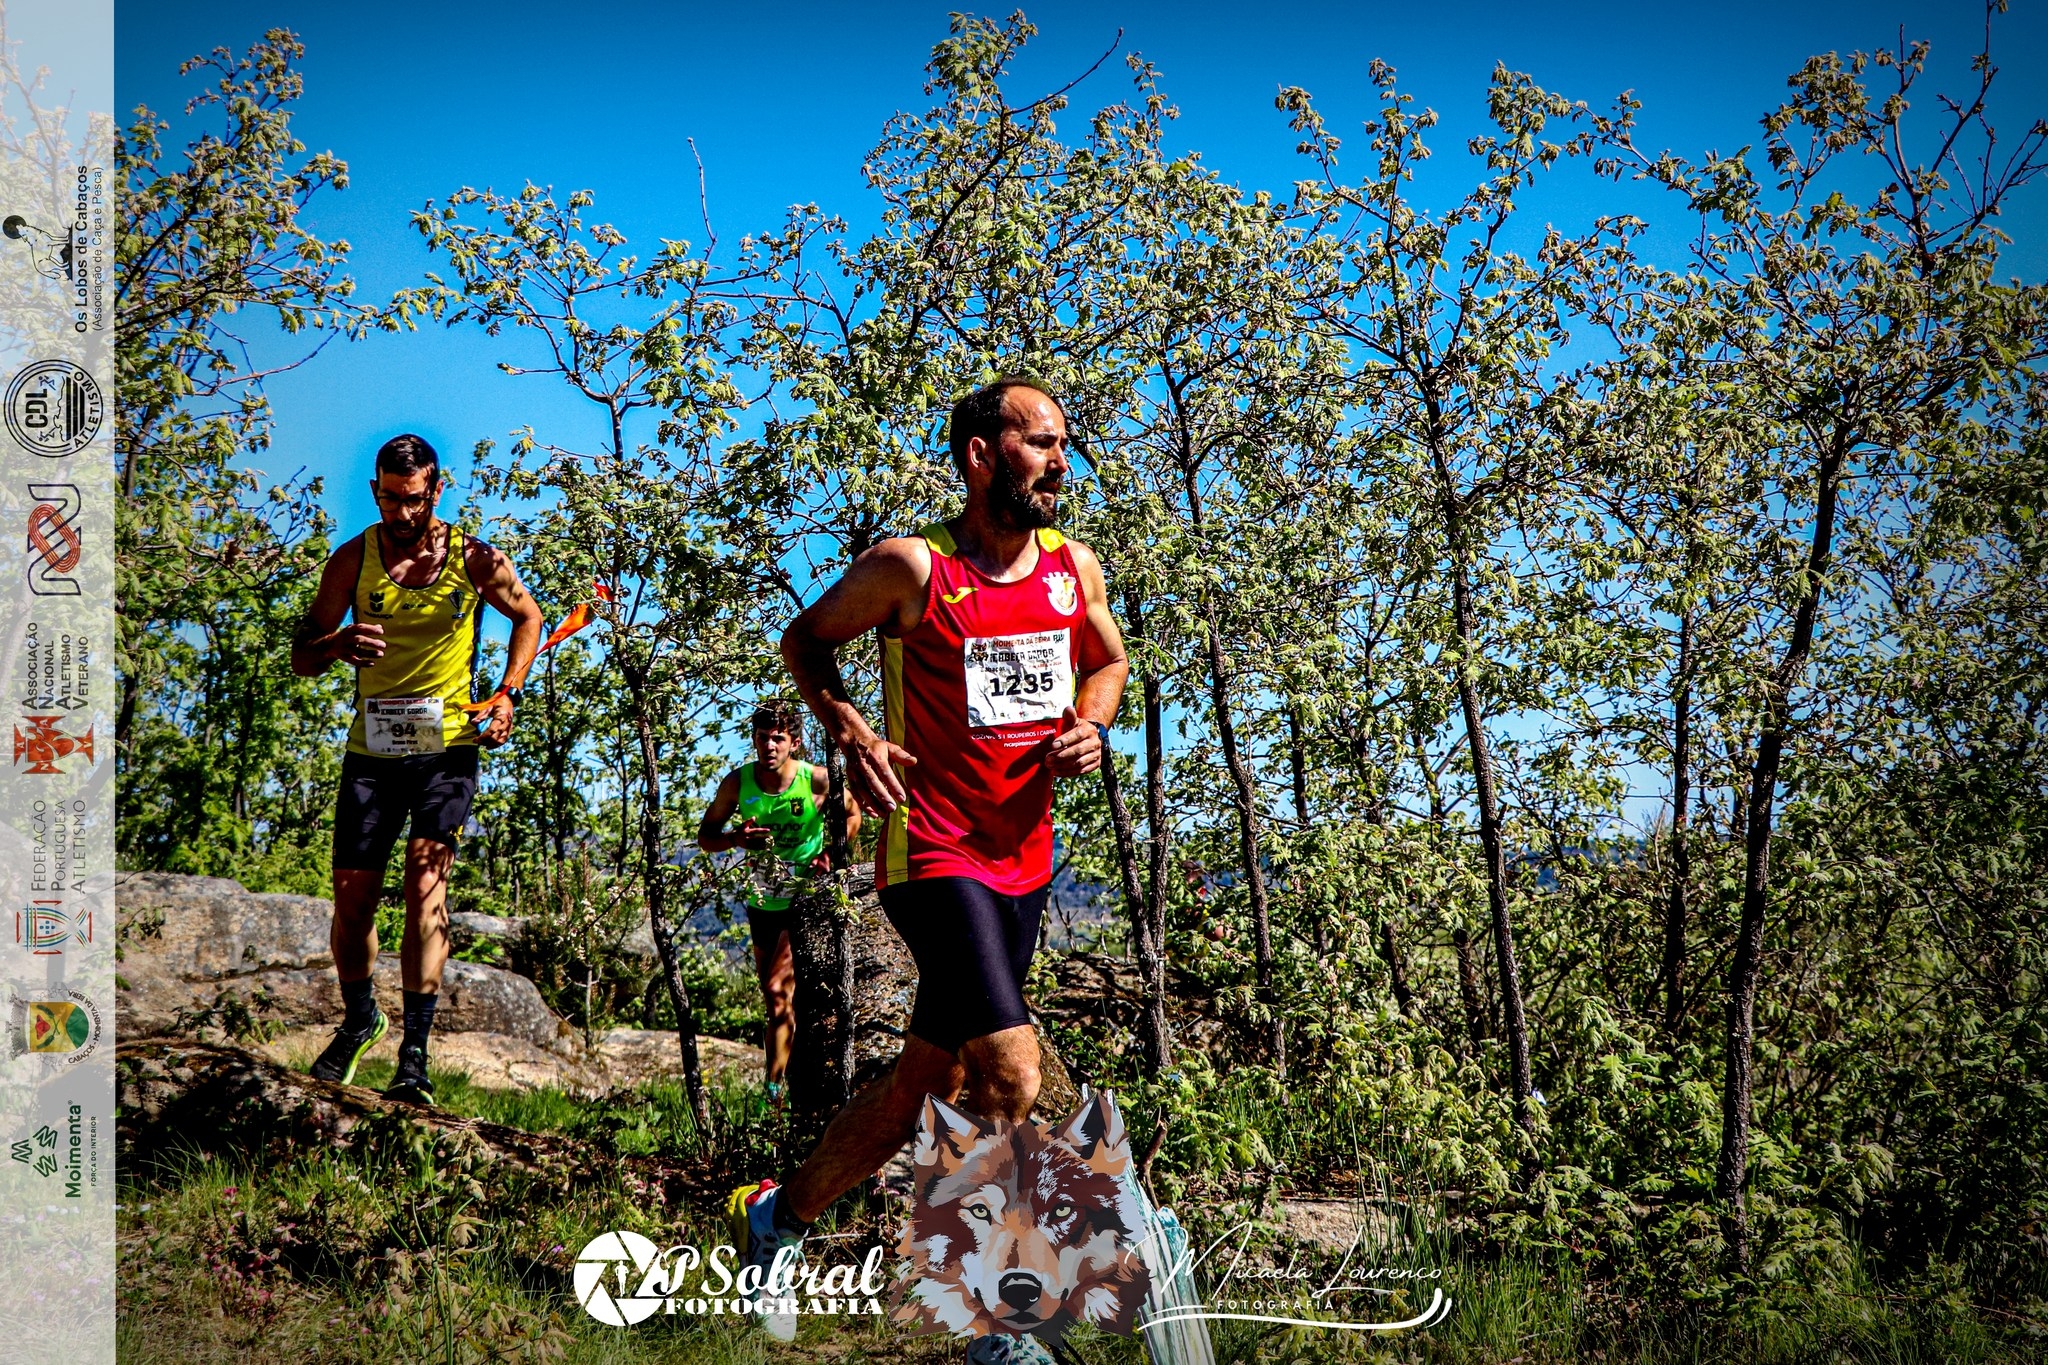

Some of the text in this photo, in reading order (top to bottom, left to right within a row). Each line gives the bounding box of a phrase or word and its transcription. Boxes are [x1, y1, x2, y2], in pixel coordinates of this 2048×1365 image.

[993, 639, 1025, 648] MOIMETA
[990, 671, 1053, 697] 1235
[391, 723, 417, 737] 94
